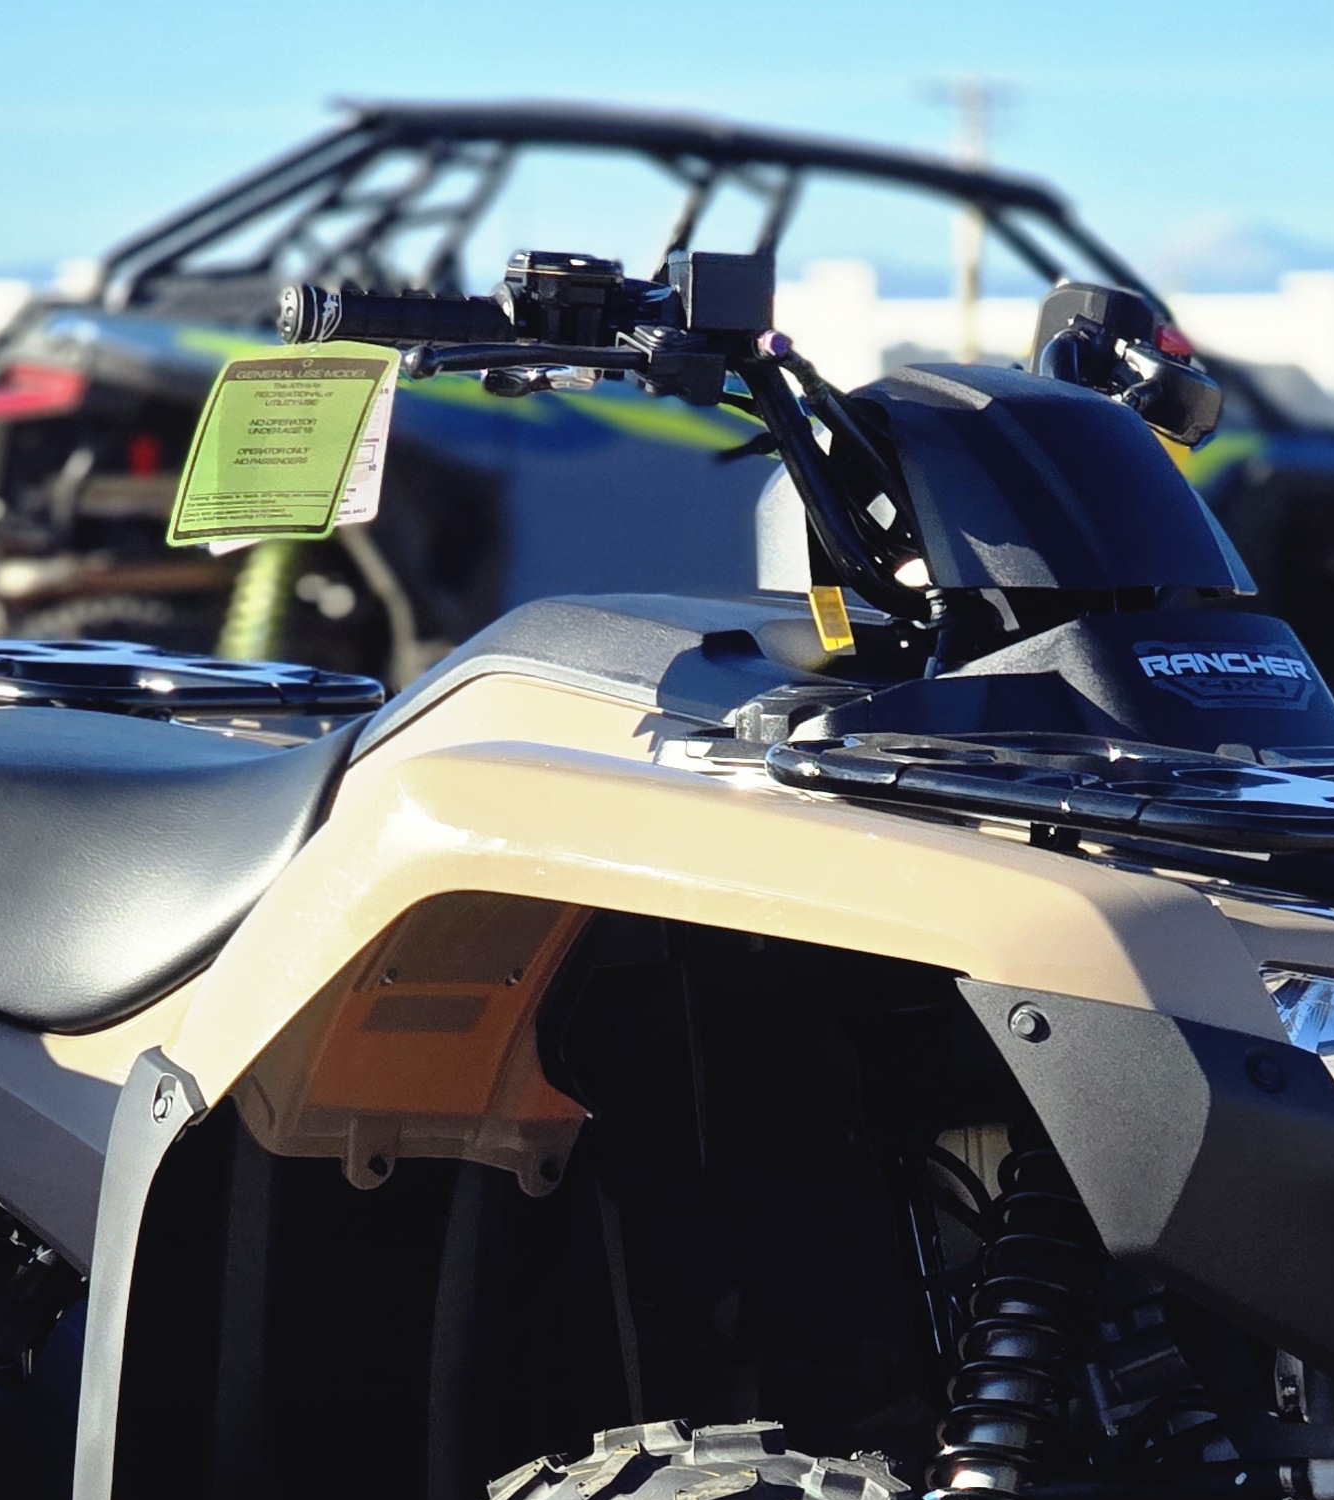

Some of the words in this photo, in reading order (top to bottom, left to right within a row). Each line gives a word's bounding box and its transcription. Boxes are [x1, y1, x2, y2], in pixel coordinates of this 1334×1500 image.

[235, 370, 294, 379] GENERAL
[297, 370, 324, 378] USE
[324, 369, 367, 378] MODEL
[265, 418, 317, 426] OPERATOR
[237, 447, 285, 455] OPERATOR
[249, 457, 309, 465] PASSENGERS
[1138, 653, 1312, 681] RANCHER
